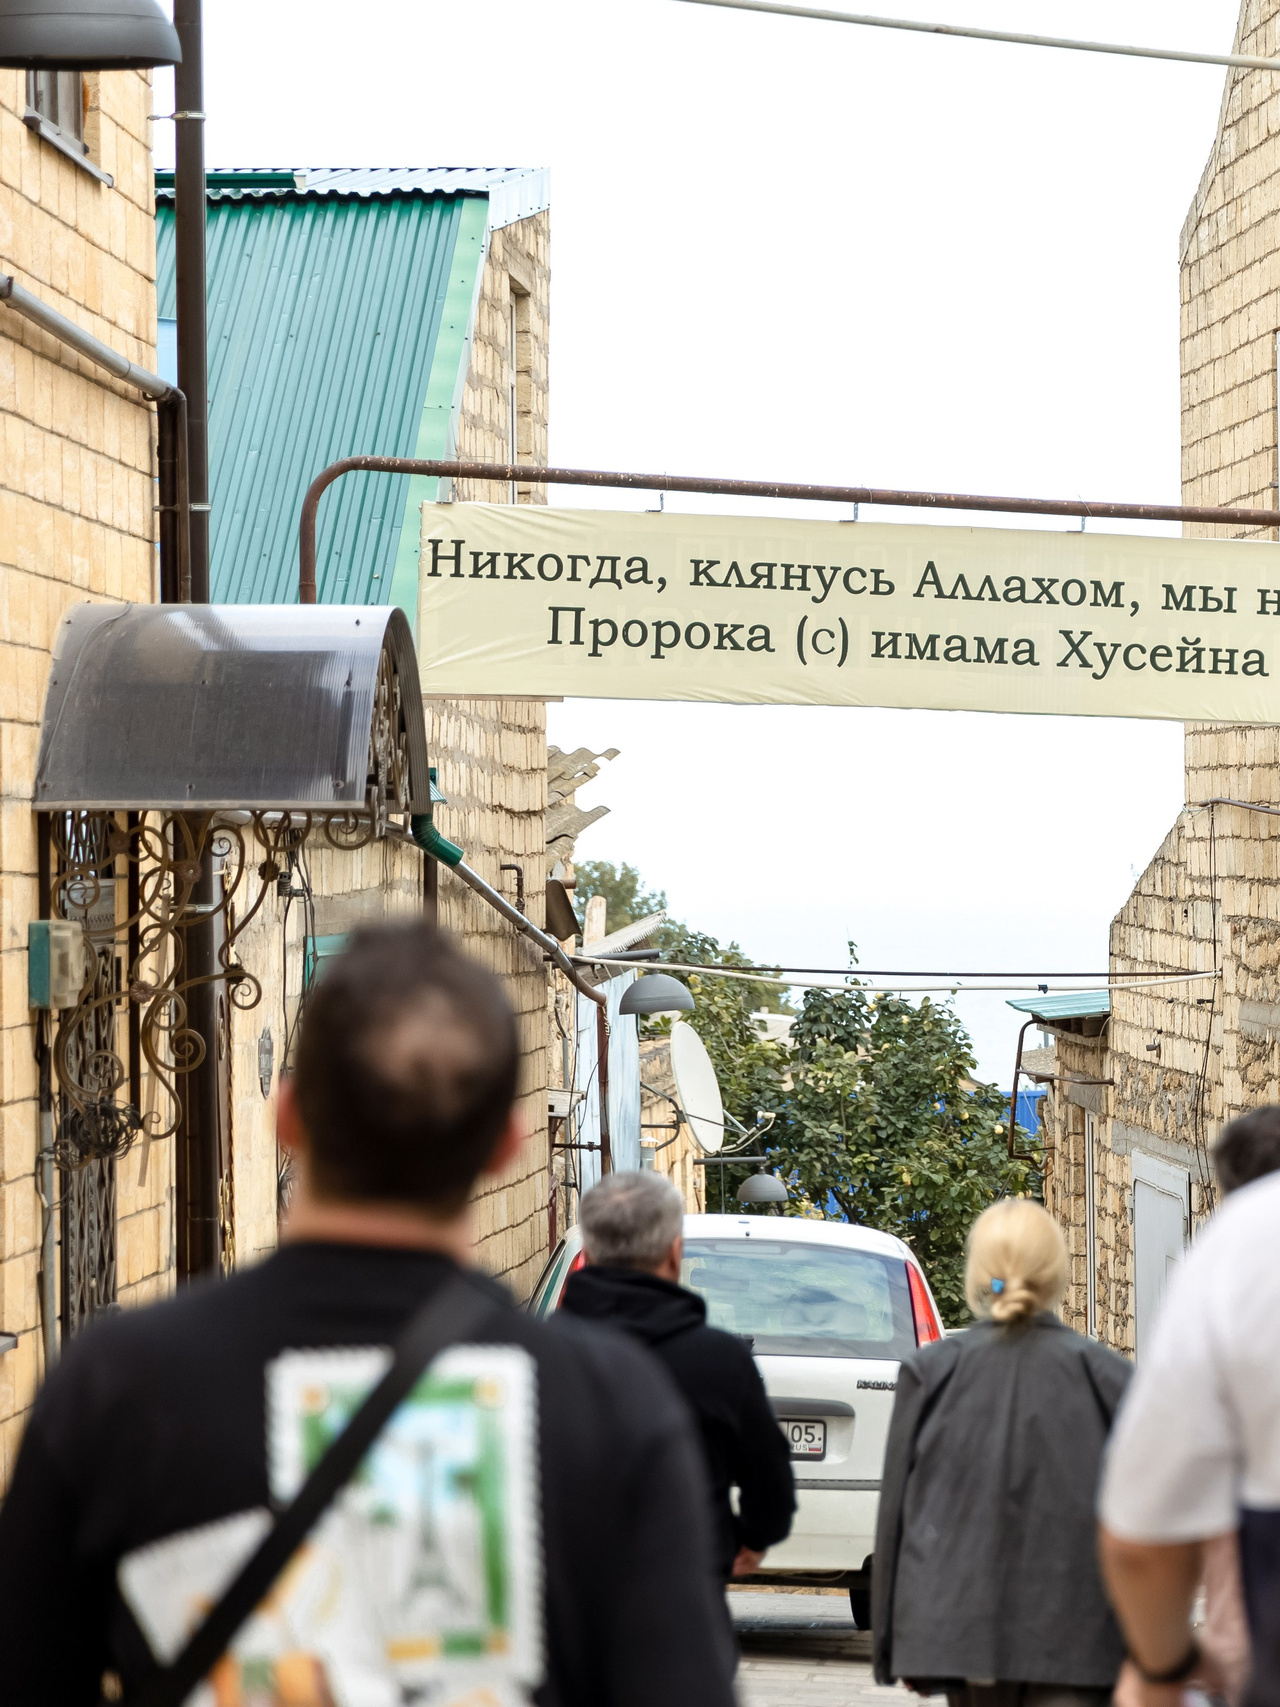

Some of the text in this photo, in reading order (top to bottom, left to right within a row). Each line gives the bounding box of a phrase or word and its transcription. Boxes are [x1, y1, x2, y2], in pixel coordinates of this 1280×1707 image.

[426, 538, 667, 594] Никогда,
[687, 556, 896, 604] клянусь
[912, 560, 1140, 618] Аллахом,
[1160, 581, 1238, 614] мы
[547, 606, 776, 660] Пророка
[796, 614, 849, 668] (с)
[870, 630, 1040, 667] имама
[1056, 629, 1270, 681] Хусейна
[791, 1425, 815, 1443] 05
